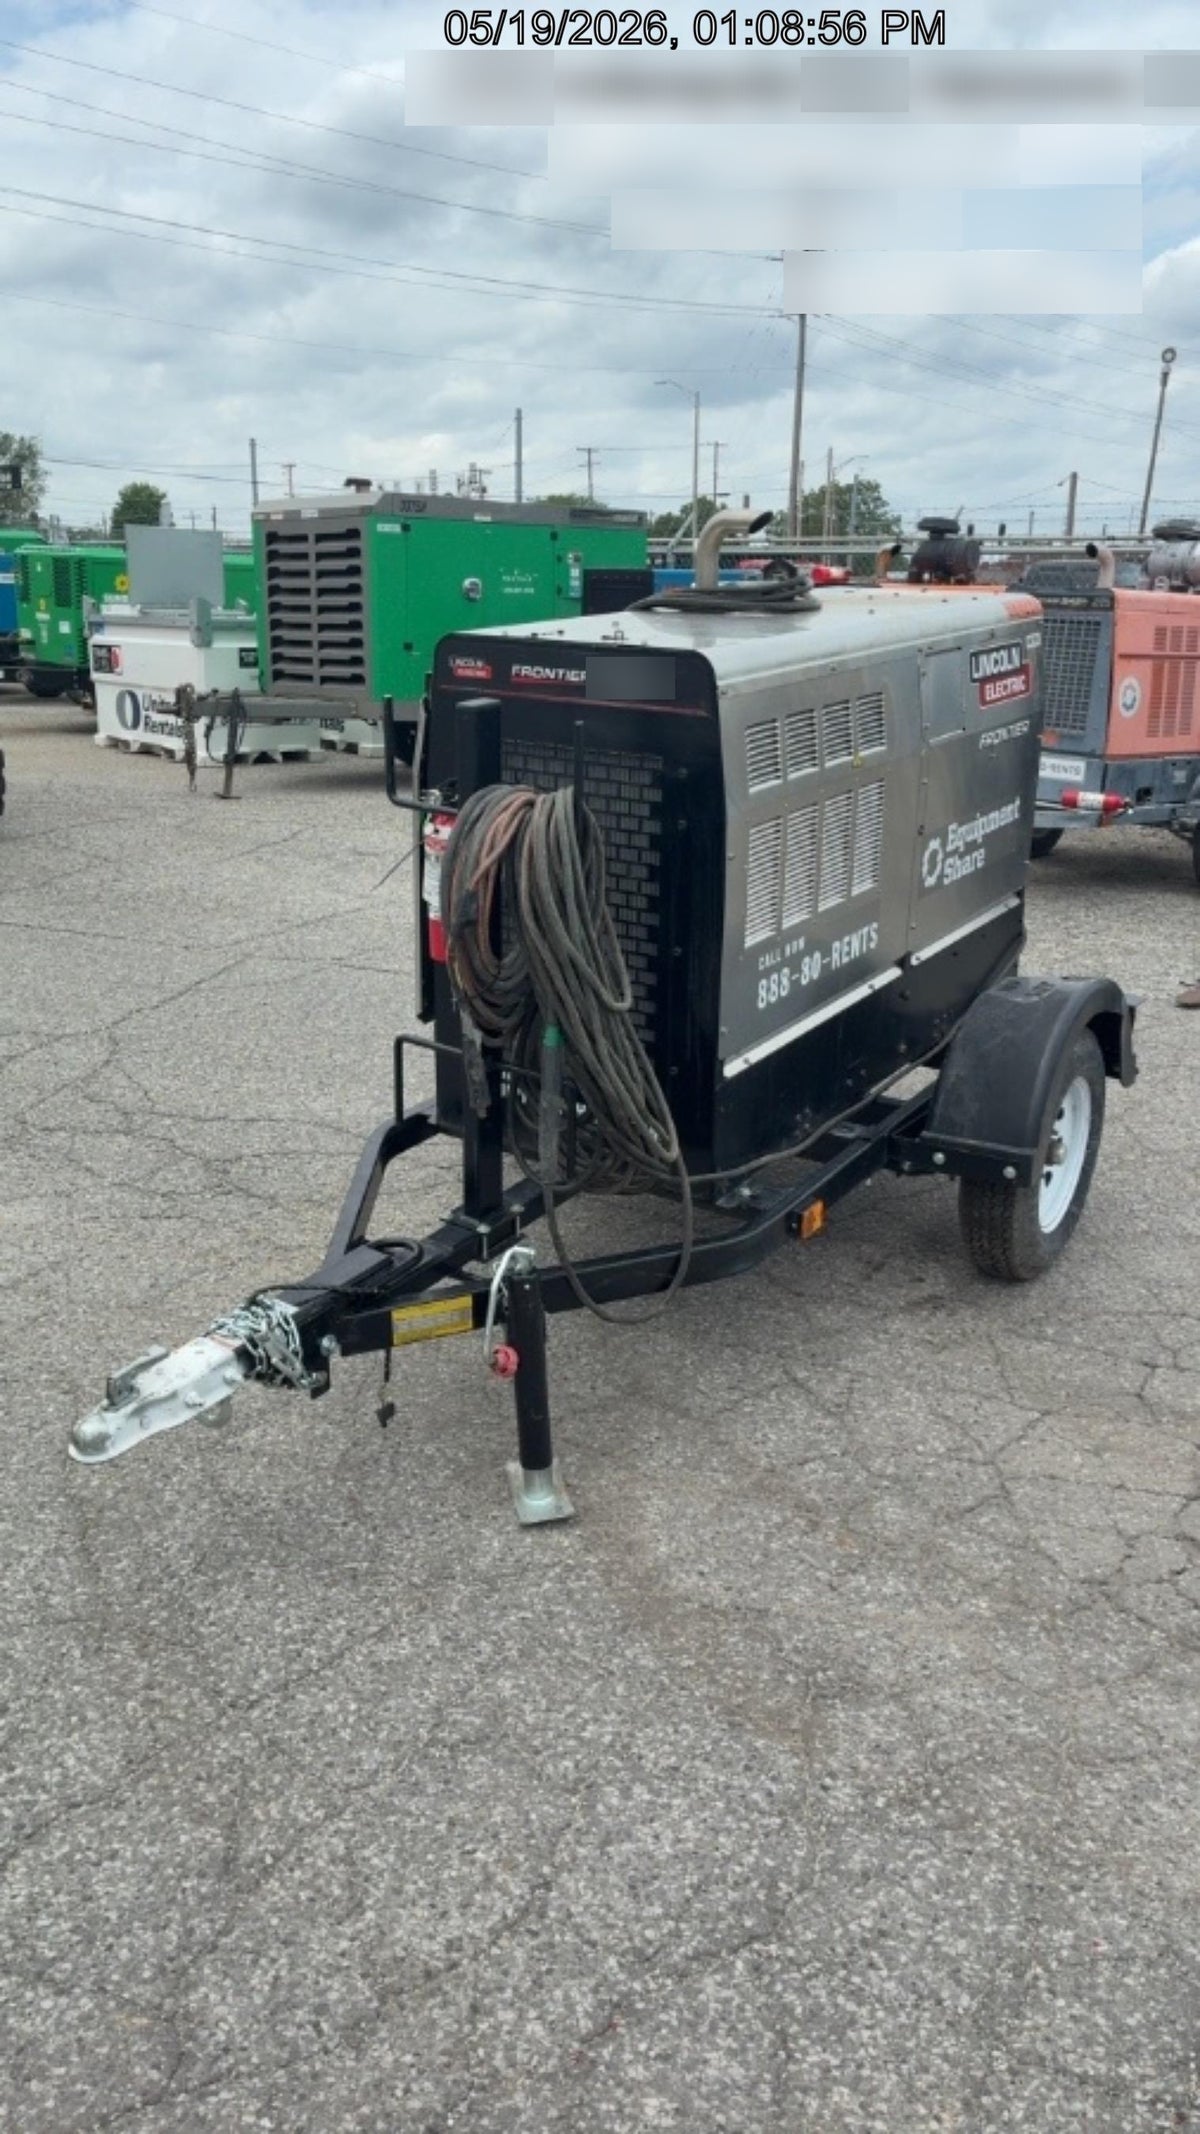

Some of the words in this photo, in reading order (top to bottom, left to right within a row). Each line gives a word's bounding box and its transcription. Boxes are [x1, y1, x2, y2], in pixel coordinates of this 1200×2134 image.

[972, 646, 1020, 679] LINCOLN
[985, 675, 1027, 701] ELECTRIC
[946, 797, 1020, 851] Equipment
[943, 848, 985, 885] Share
[758, 922, 879, 1009] 888-80-RENTS
